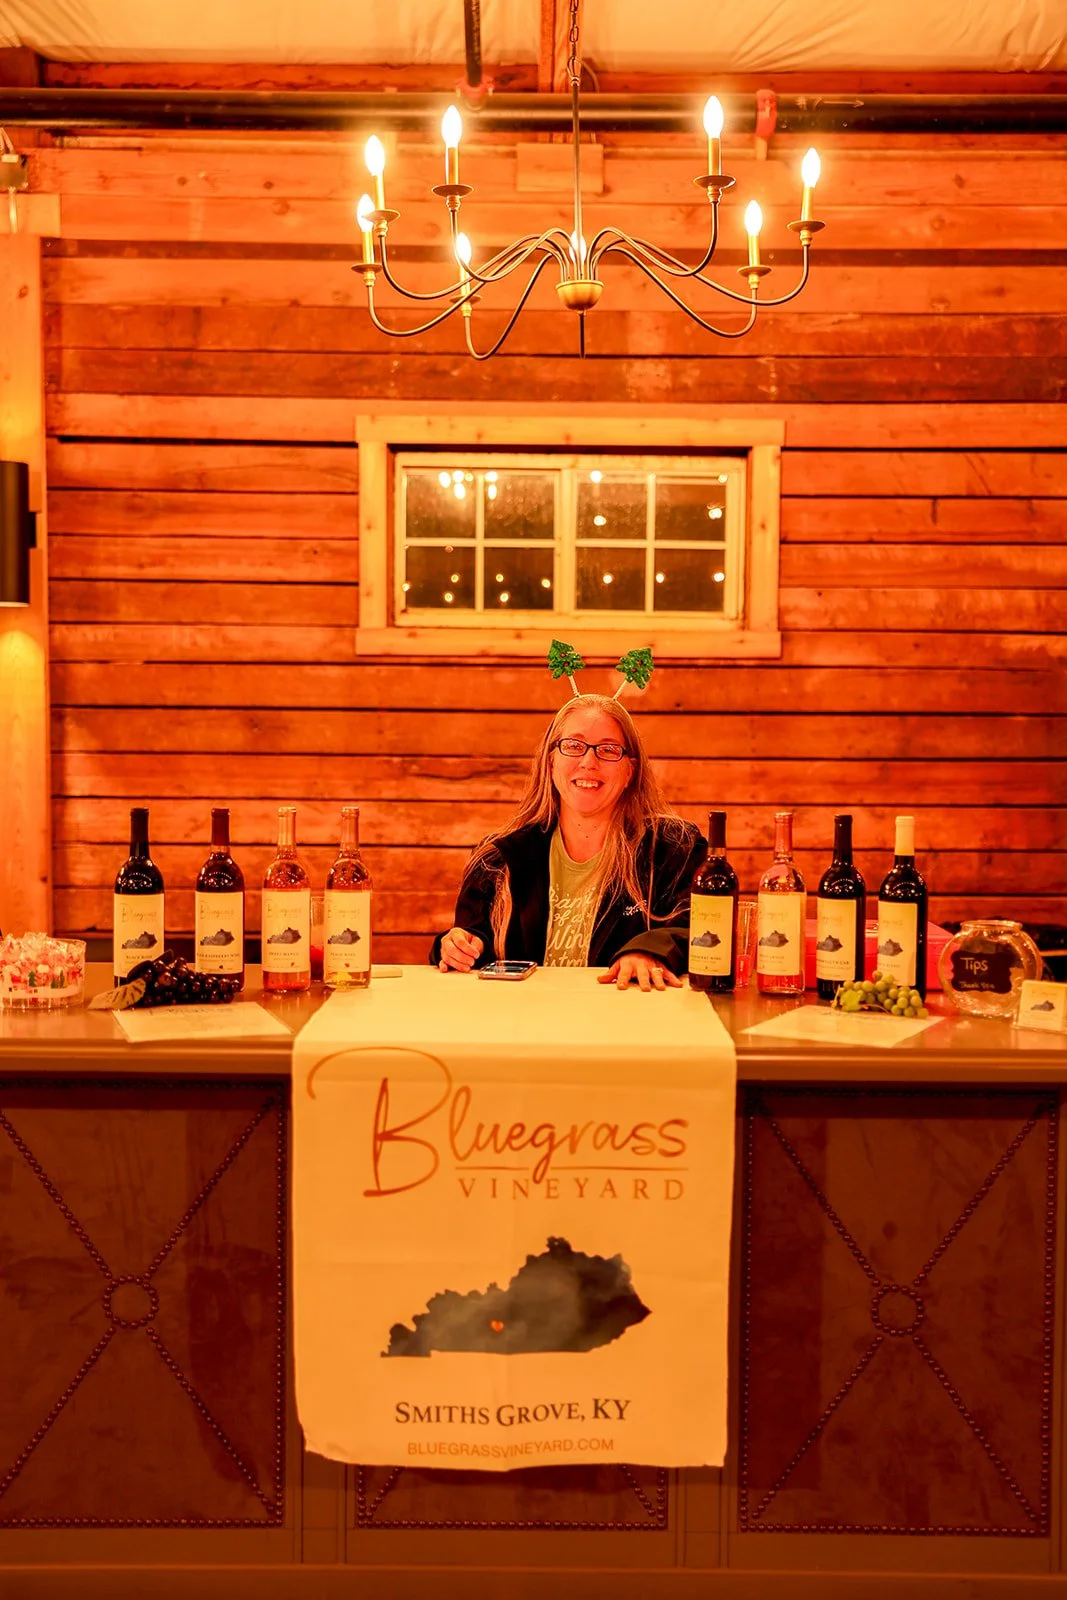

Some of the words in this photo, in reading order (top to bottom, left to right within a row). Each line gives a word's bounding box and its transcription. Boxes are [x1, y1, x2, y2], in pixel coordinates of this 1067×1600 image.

[553, 909, 573, 927] of
[960, 957, 988, 975] Tips
[306, 1046, 689, 1197] Bluegrass
[457, 1177, 685, 1200] VINEYARD
[395, 1401, 490, 1425] SMITHS
[592, 1397, 631, 1421] KY
[407, 1437, 615, 1459] BLUEGRASSVINEYARD.COM
